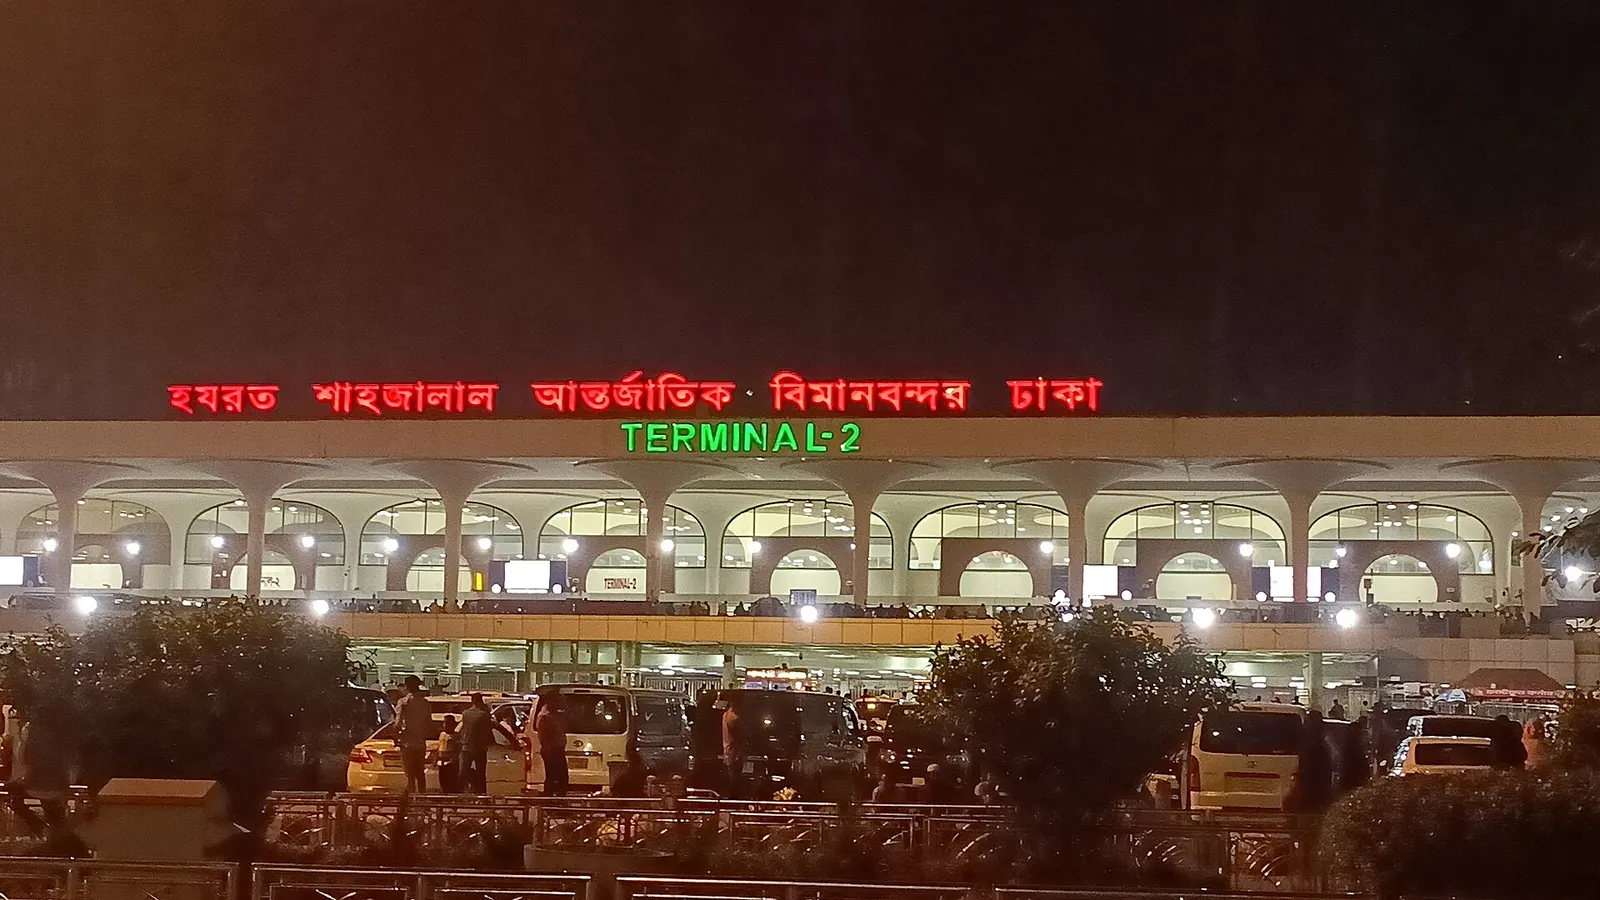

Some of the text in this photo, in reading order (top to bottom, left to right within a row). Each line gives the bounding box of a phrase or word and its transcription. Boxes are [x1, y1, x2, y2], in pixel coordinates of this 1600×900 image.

[167, 371, 1103, 415] হযরত শাহজালাল আন্তর্জাতিক বিমানবন্দর ঢাকা
